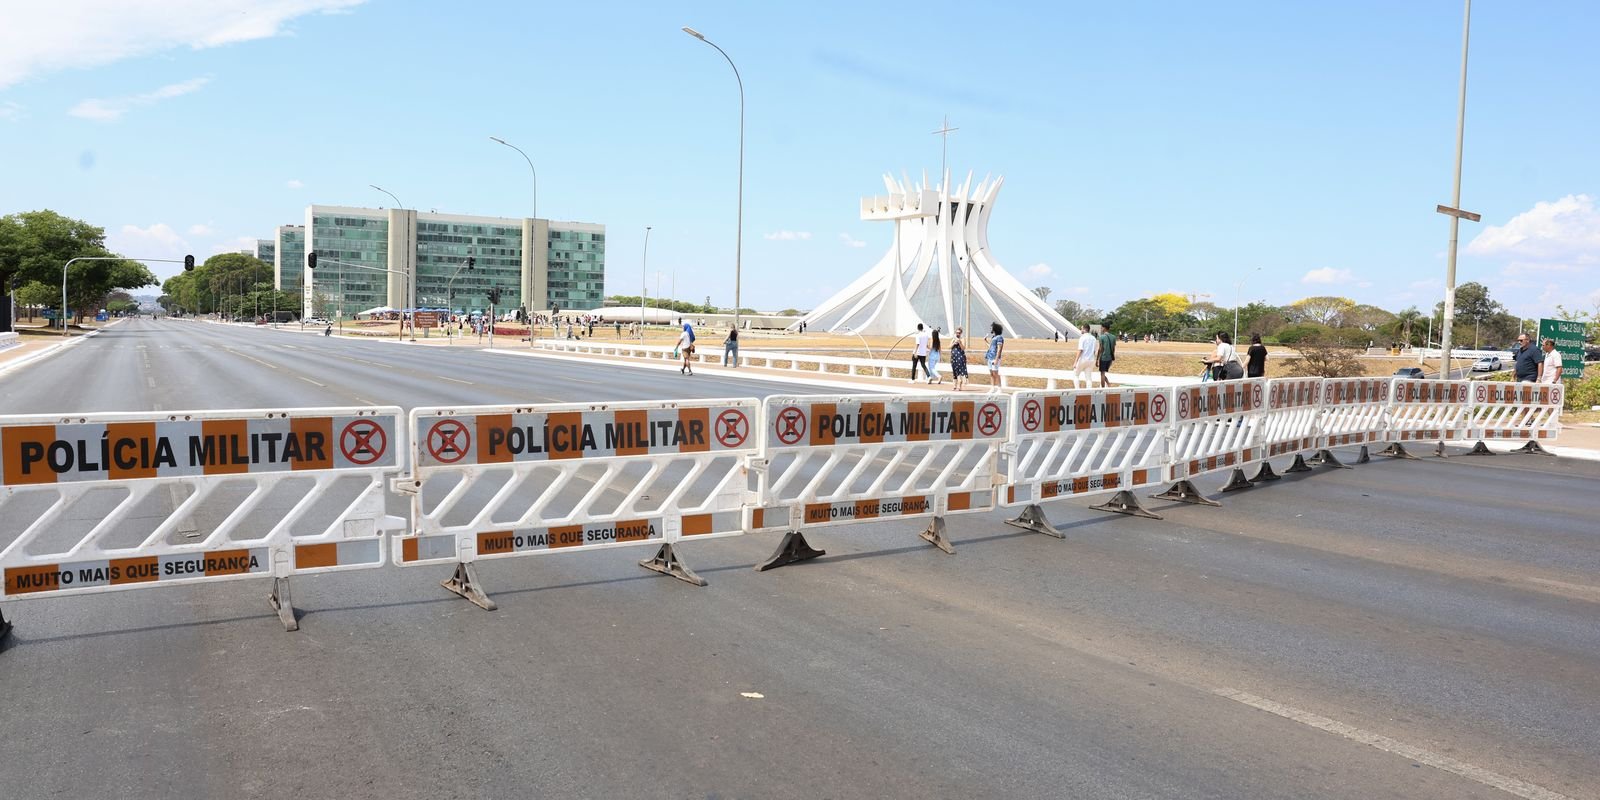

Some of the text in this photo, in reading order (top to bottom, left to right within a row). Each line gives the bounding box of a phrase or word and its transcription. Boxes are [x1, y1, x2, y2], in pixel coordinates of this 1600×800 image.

[1223, 392, 1251, 408] MILITAR
[1520, 390, 1548, 402] MILITAR
[819, 408, 970, 438] POLÍCIA MILITAR
[1049, 400, 1146, 426] POLÍCIA MILITAR
[489, 418, 705, 455] POLÍCIA MILITAR
[20, 431, 326, 474] POLÍCIA MILITAR
[810, 500, 930, 520] MUITO MAIS QUE SEGURANÇA
[484, 524, 656, 551] MUITO MAIS QUE SEGURANÇA
[16, 556, 259, 588] MUITO MAIS QUE SEGURANÇA
